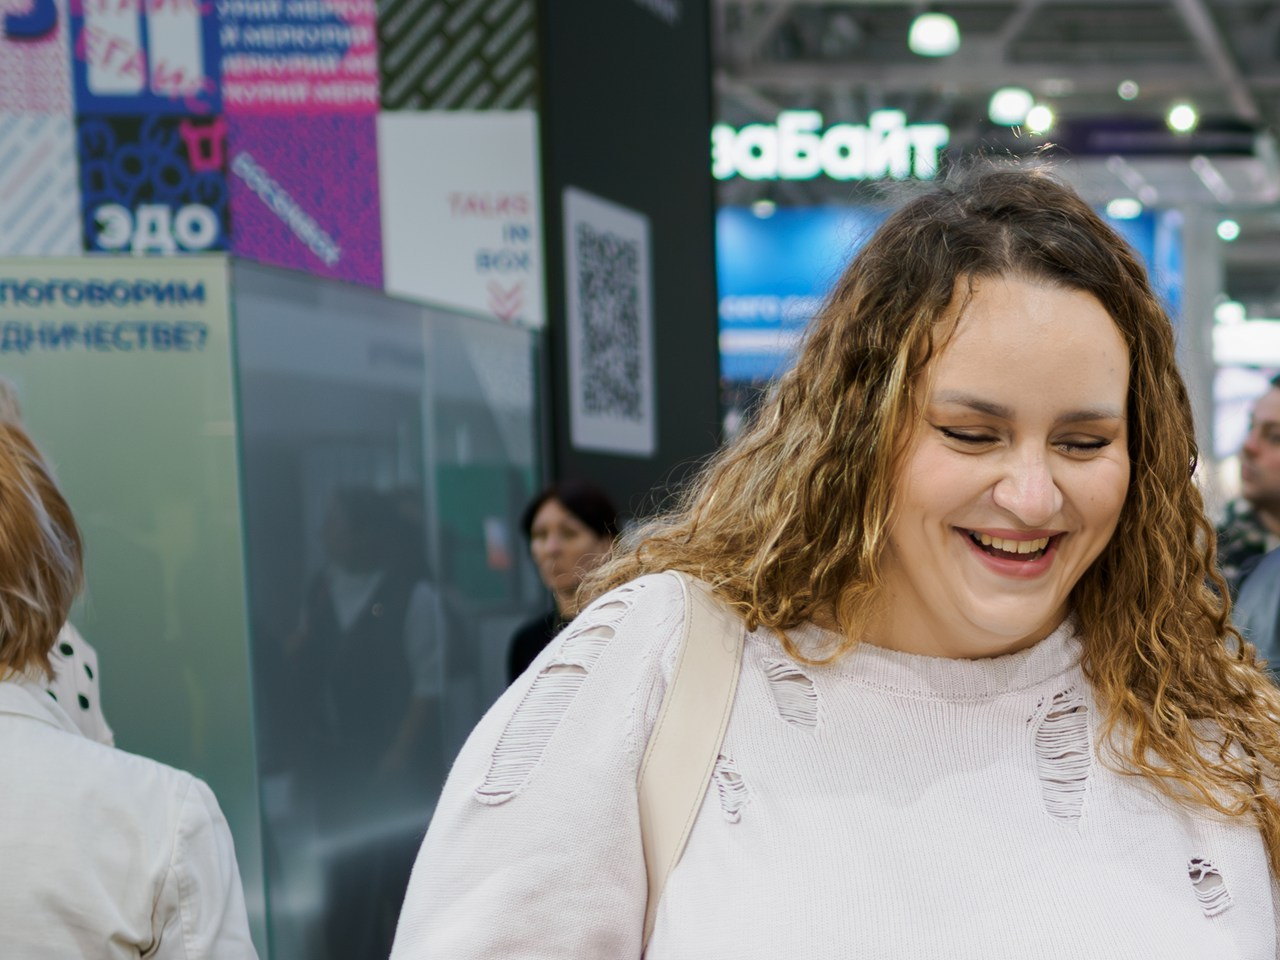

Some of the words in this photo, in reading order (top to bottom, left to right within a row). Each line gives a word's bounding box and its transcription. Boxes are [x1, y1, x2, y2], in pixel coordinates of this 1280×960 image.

[93, 202, 218, 256] ЭДО
[502, 223, 529, 244] IN
[475, 248, 529, 274] BOX
[0, 278, 205, 308] ПОГОВОРИМ
